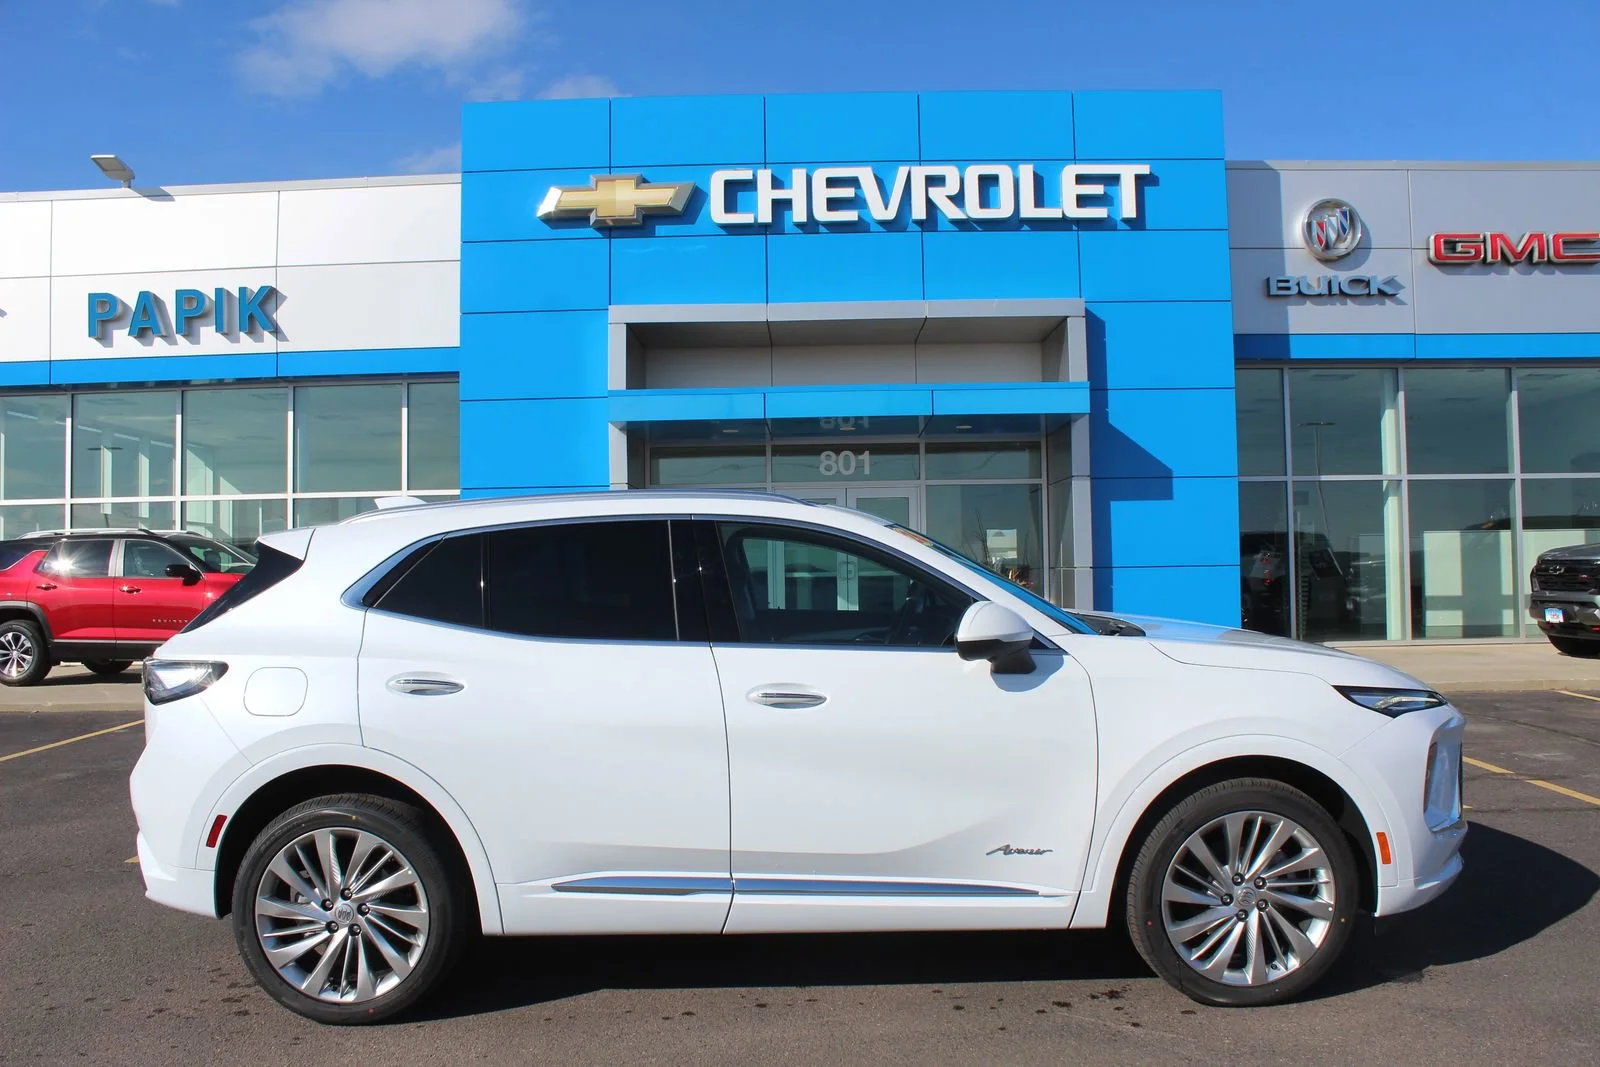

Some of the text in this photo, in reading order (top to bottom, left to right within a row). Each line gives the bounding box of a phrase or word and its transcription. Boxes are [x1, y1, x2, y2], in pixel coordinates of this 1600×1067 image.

[710, 164, 1151, 224] CHEVROLET
[1427, 231, 1600, 263] GMC
[1267, 275, 1404, 297] BUICK
[87, 285, 275, 339] PAPIK
[819, 450, 870, 475] 801
